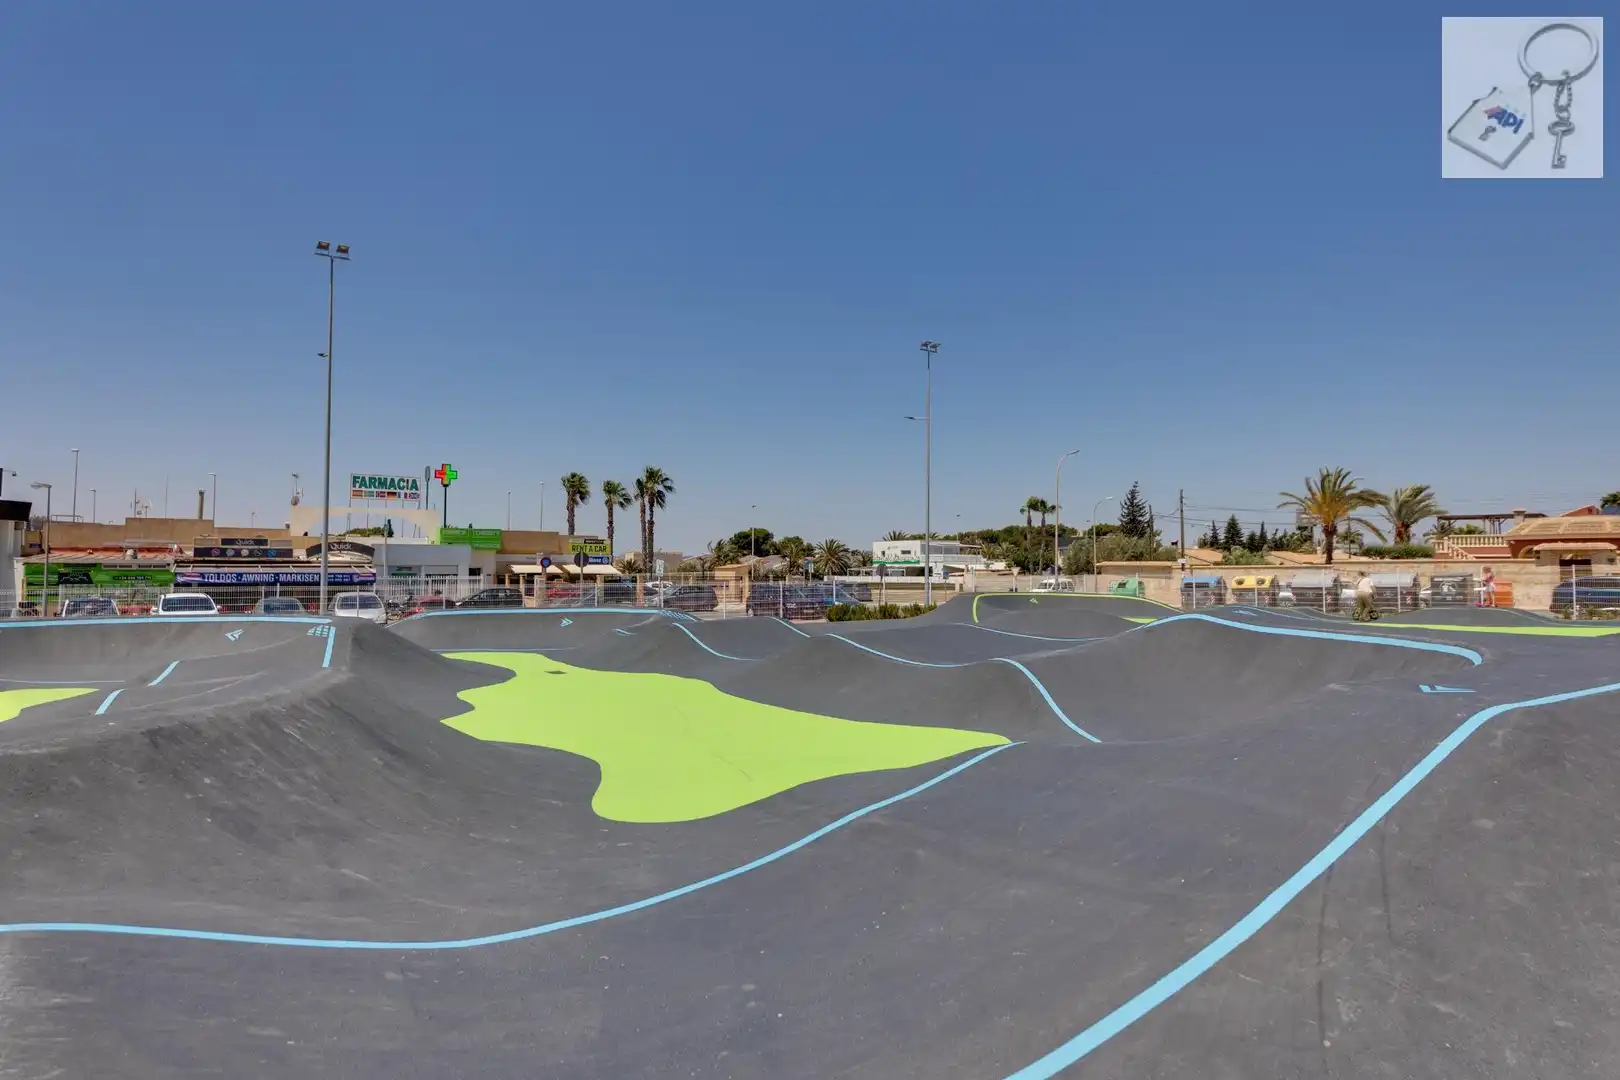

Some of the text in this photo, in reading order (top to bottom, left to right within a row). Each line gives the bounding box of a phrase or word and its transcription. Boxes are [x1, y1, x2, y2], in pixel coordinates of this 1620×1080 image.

[352, 475, 419, 491] FARMACIA
[204, 573, 237, 582] TOLDOS
[242, 573, 275, 582] AWNING
[279, 573, 320, 582] MARKISEN
